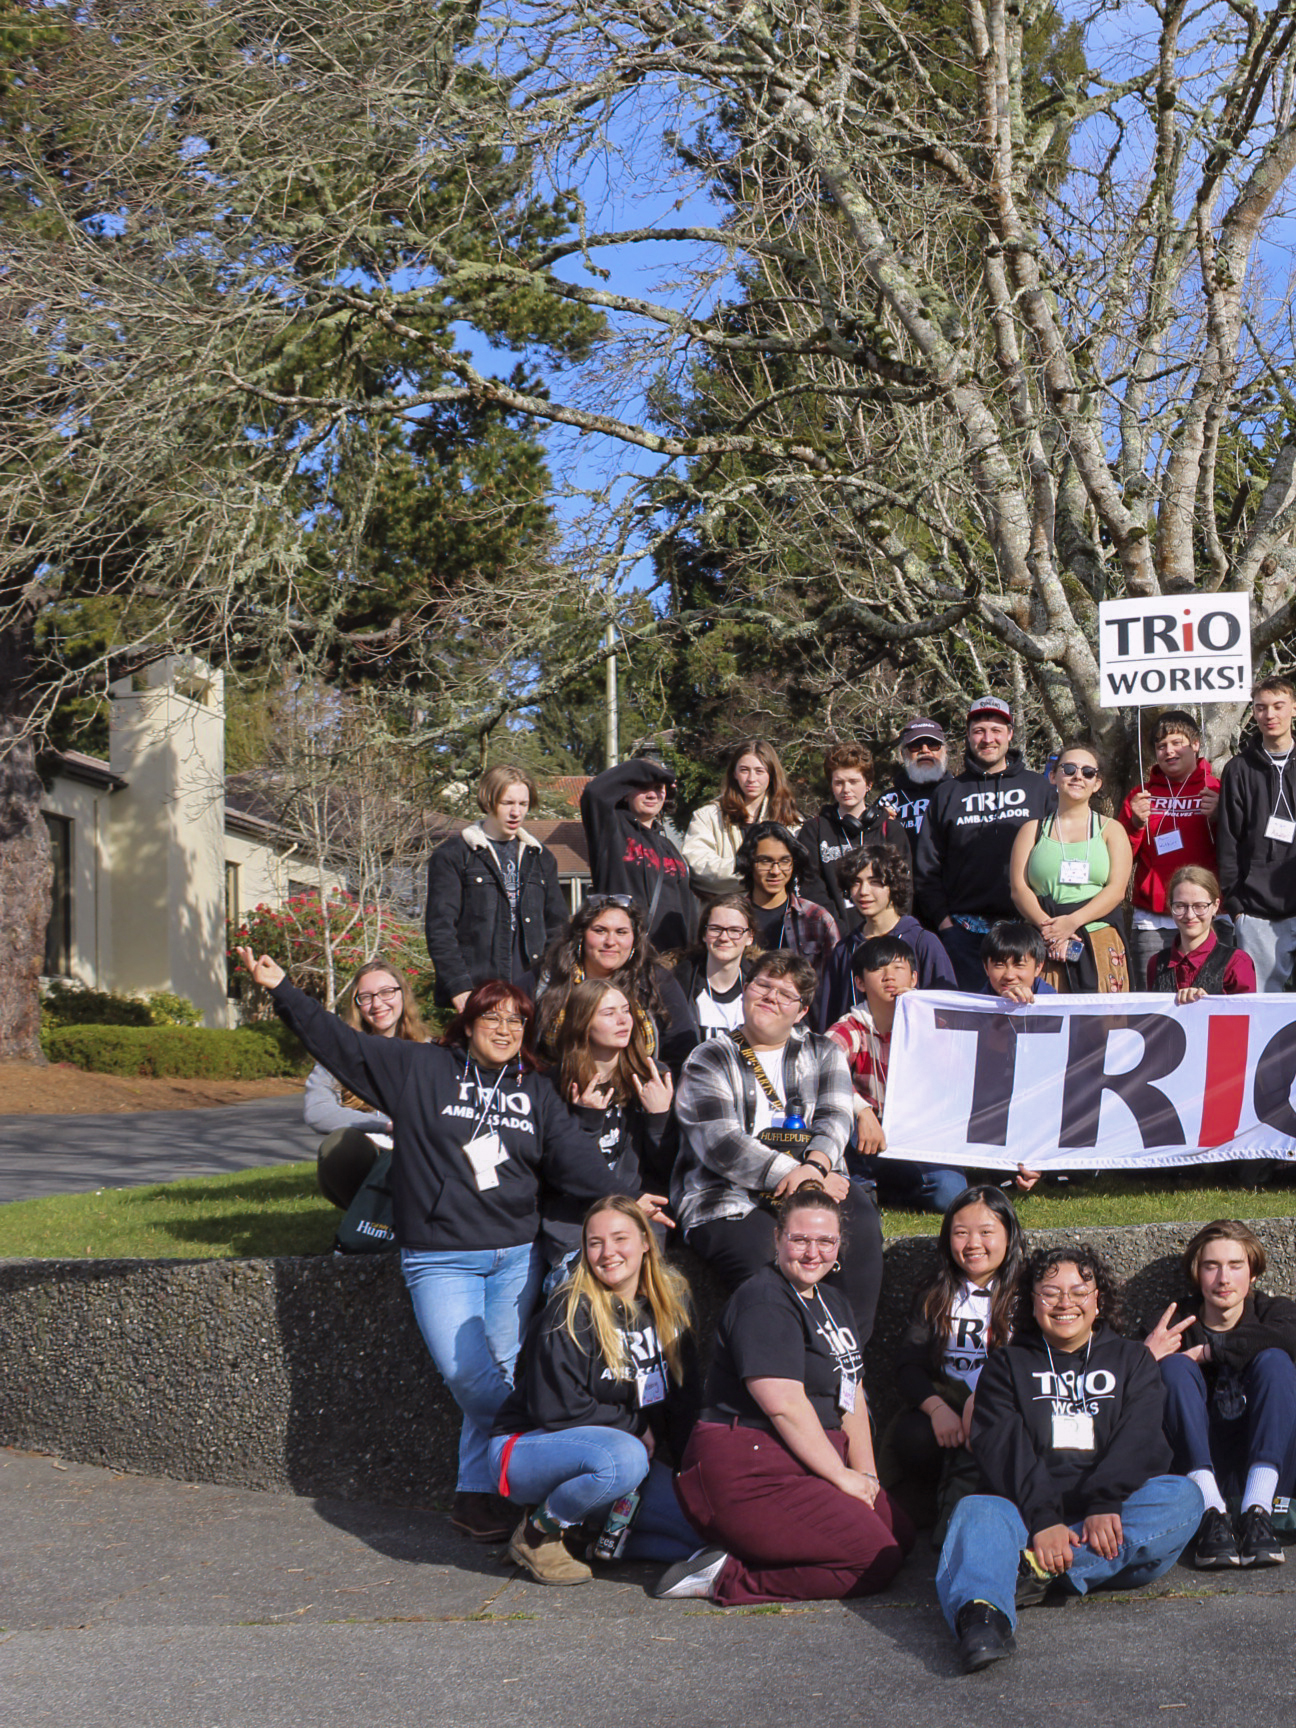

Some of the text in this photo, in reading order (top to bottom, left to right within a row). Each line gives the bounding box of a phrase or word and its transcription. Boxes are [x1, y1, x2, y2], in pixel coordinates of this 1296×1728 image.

[1107, 665, 1244, 695] WORKS!
[961, 789, 1026, 812] TRIO
[1148, 798, 1202, 810] TRINIT
[760, 1131, 812, 1143] HUFFLEPUFF
[1032, 1369, 1116, 1401] TRIO
[1051, 1400, 1100, 1417] WOS
